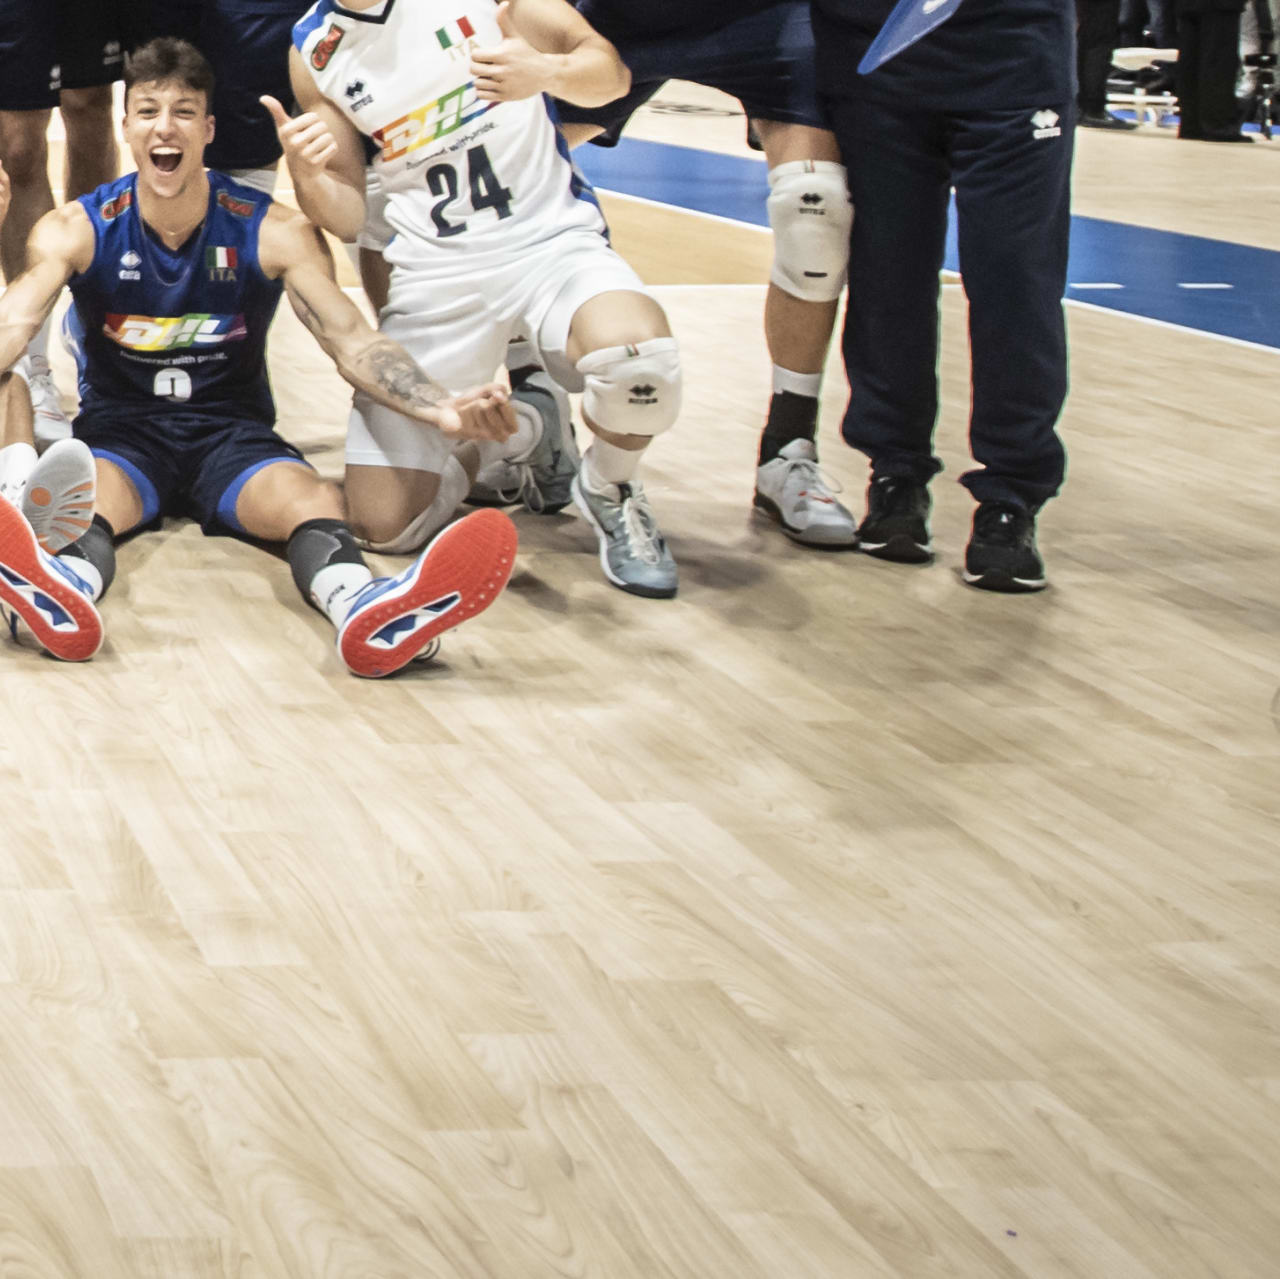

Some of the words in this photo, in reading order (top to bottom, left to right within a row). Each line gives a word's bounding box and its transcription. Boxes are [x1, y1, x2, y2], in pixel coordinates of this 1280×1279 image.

[425, 144, 513, 239] 24
[208, 268, 238, 282] ITA
[121, 319, 226, 343] DHL
[172, 354, 196, 365] with
